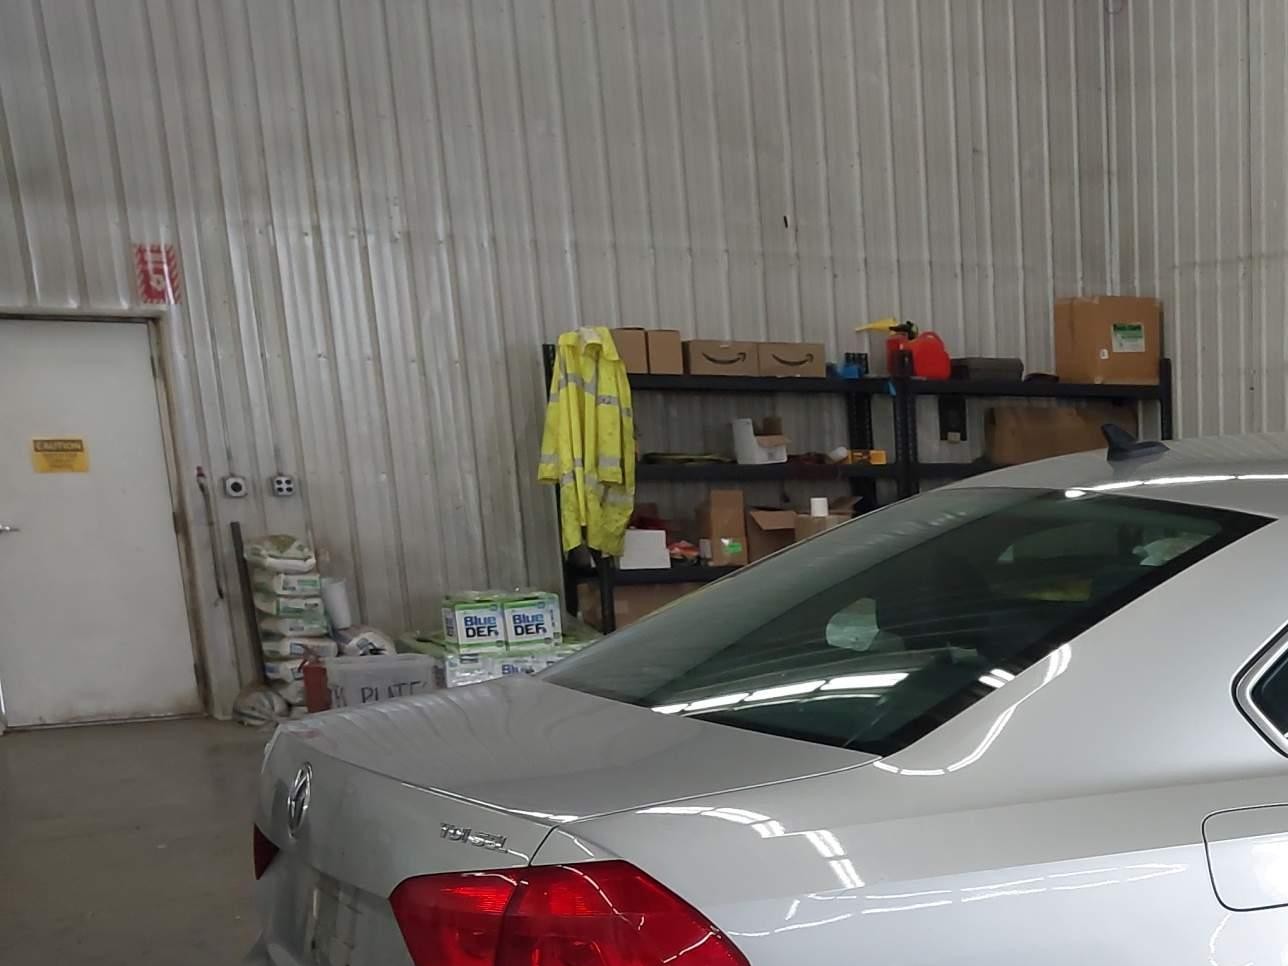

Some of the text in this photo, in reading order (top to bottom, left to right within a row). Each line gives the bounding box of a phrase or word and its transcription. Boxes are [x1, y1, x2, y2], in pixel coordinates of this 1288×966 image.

[464, 615, 496, 626] Blue
[512, 613, 544, 625] Blue
[465, 625, 498, 638] DEF
[514, 623, 547, 636] DEF
